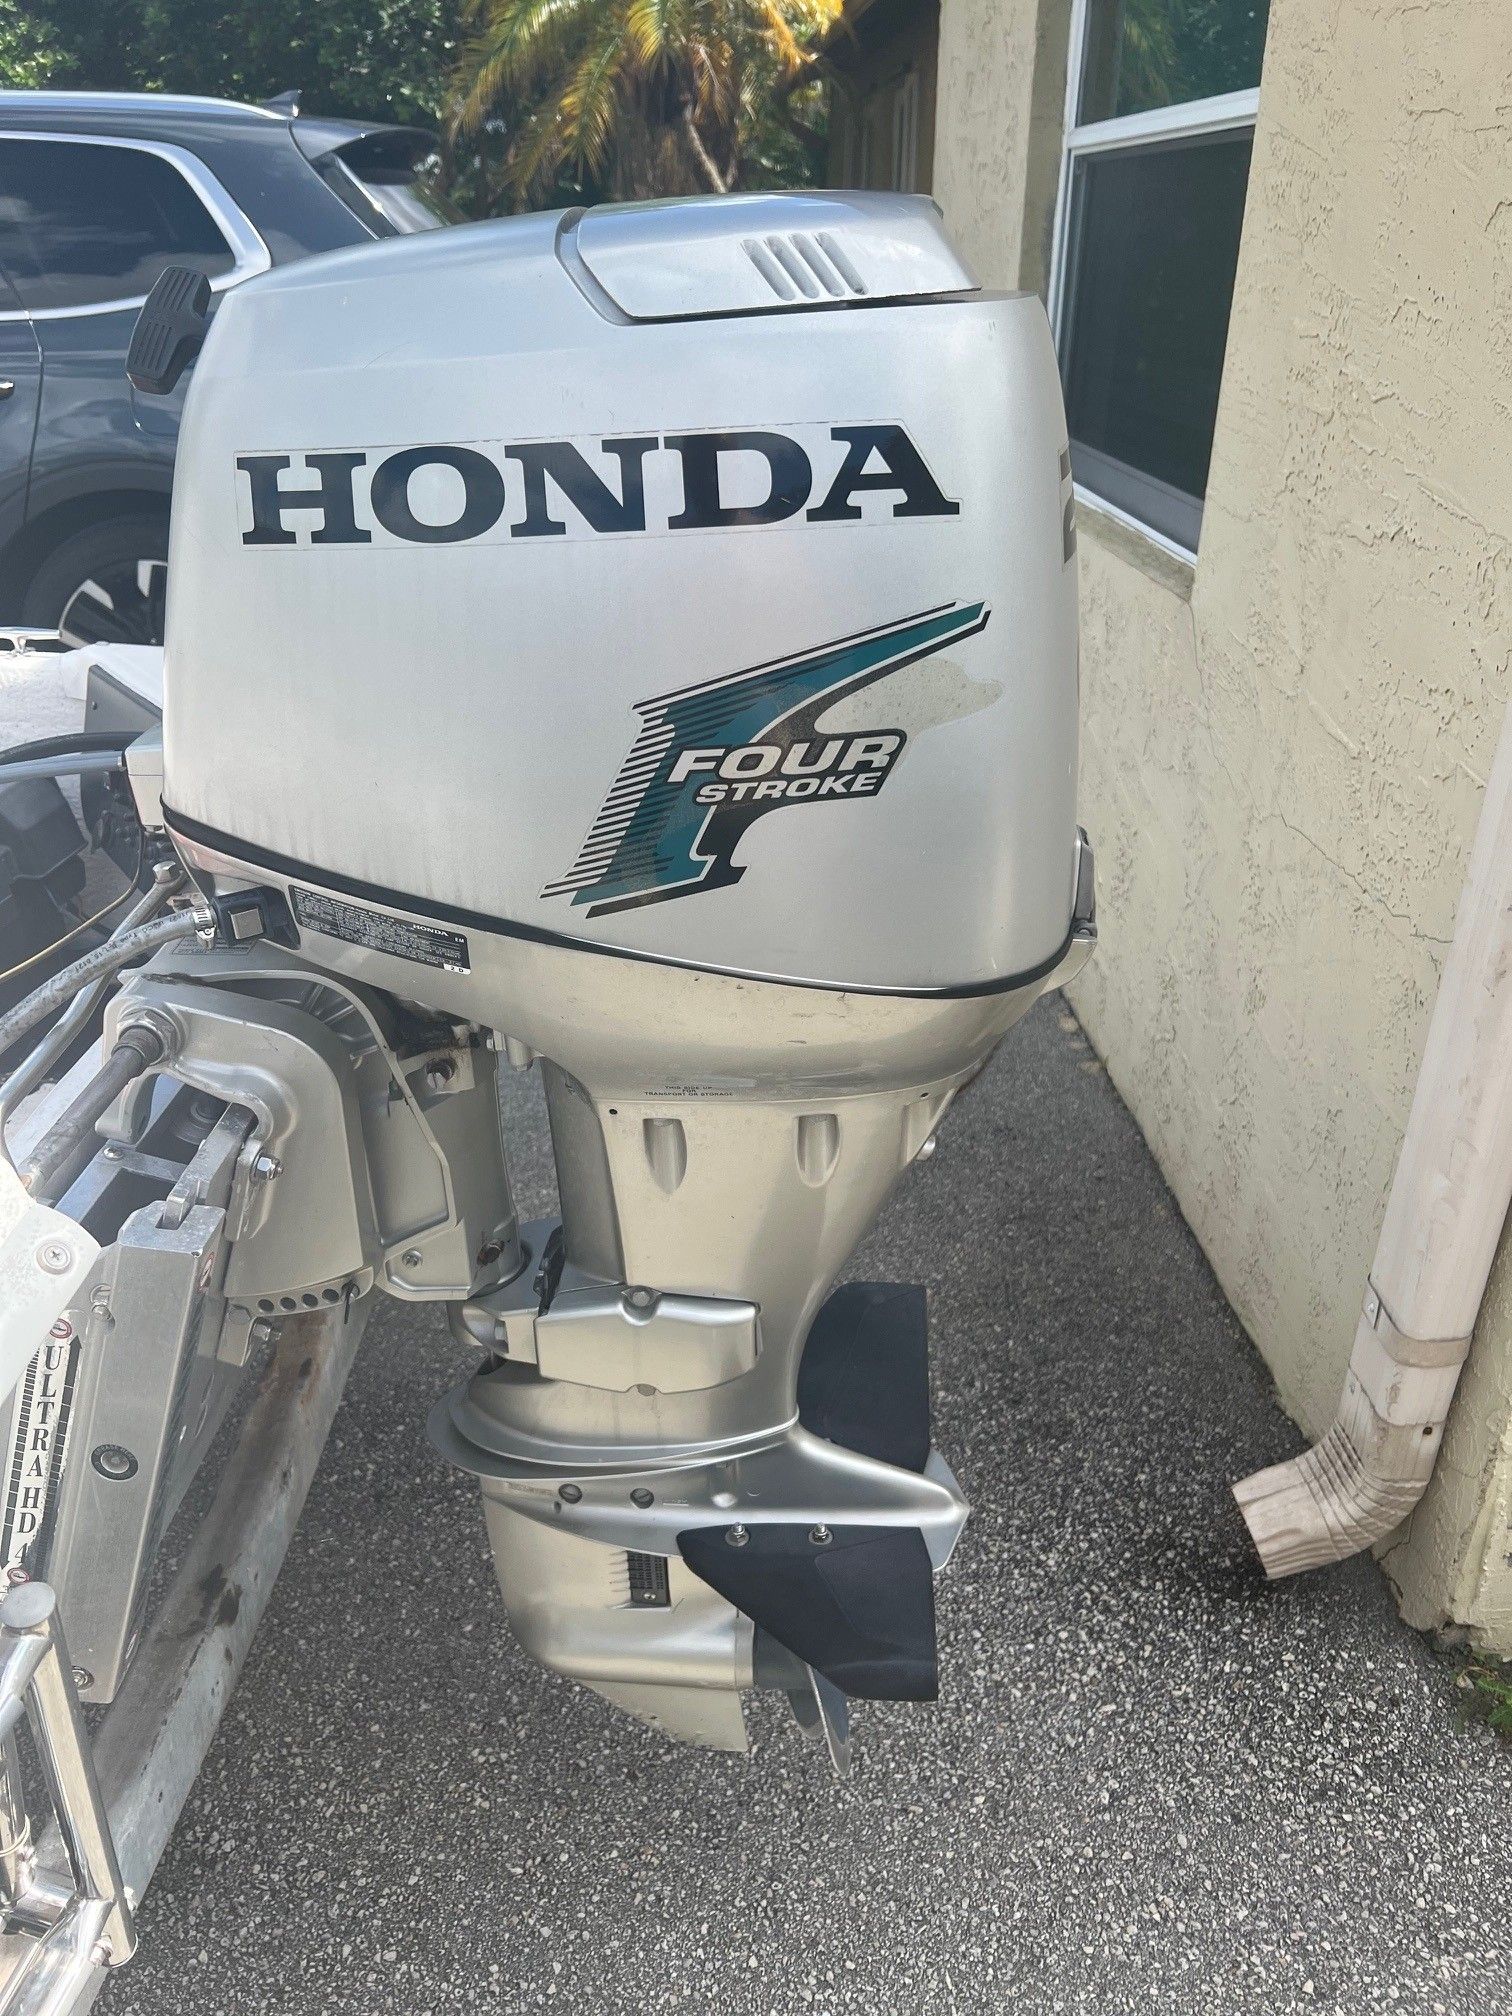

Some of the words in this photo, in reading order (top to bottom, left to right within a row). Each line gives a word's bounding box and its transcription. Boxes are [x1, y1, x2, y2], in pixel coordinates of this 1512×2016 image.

[236, 424, 960, 545] HONDA
[667, 735, 900, 783] FOUR
[696, 771, 882, 803] STROKE
[412, 923, 449, 937] HONDA
[26, 1344, 64, 1477] ULTRA
[17, 1486, 42, 1534] HD
